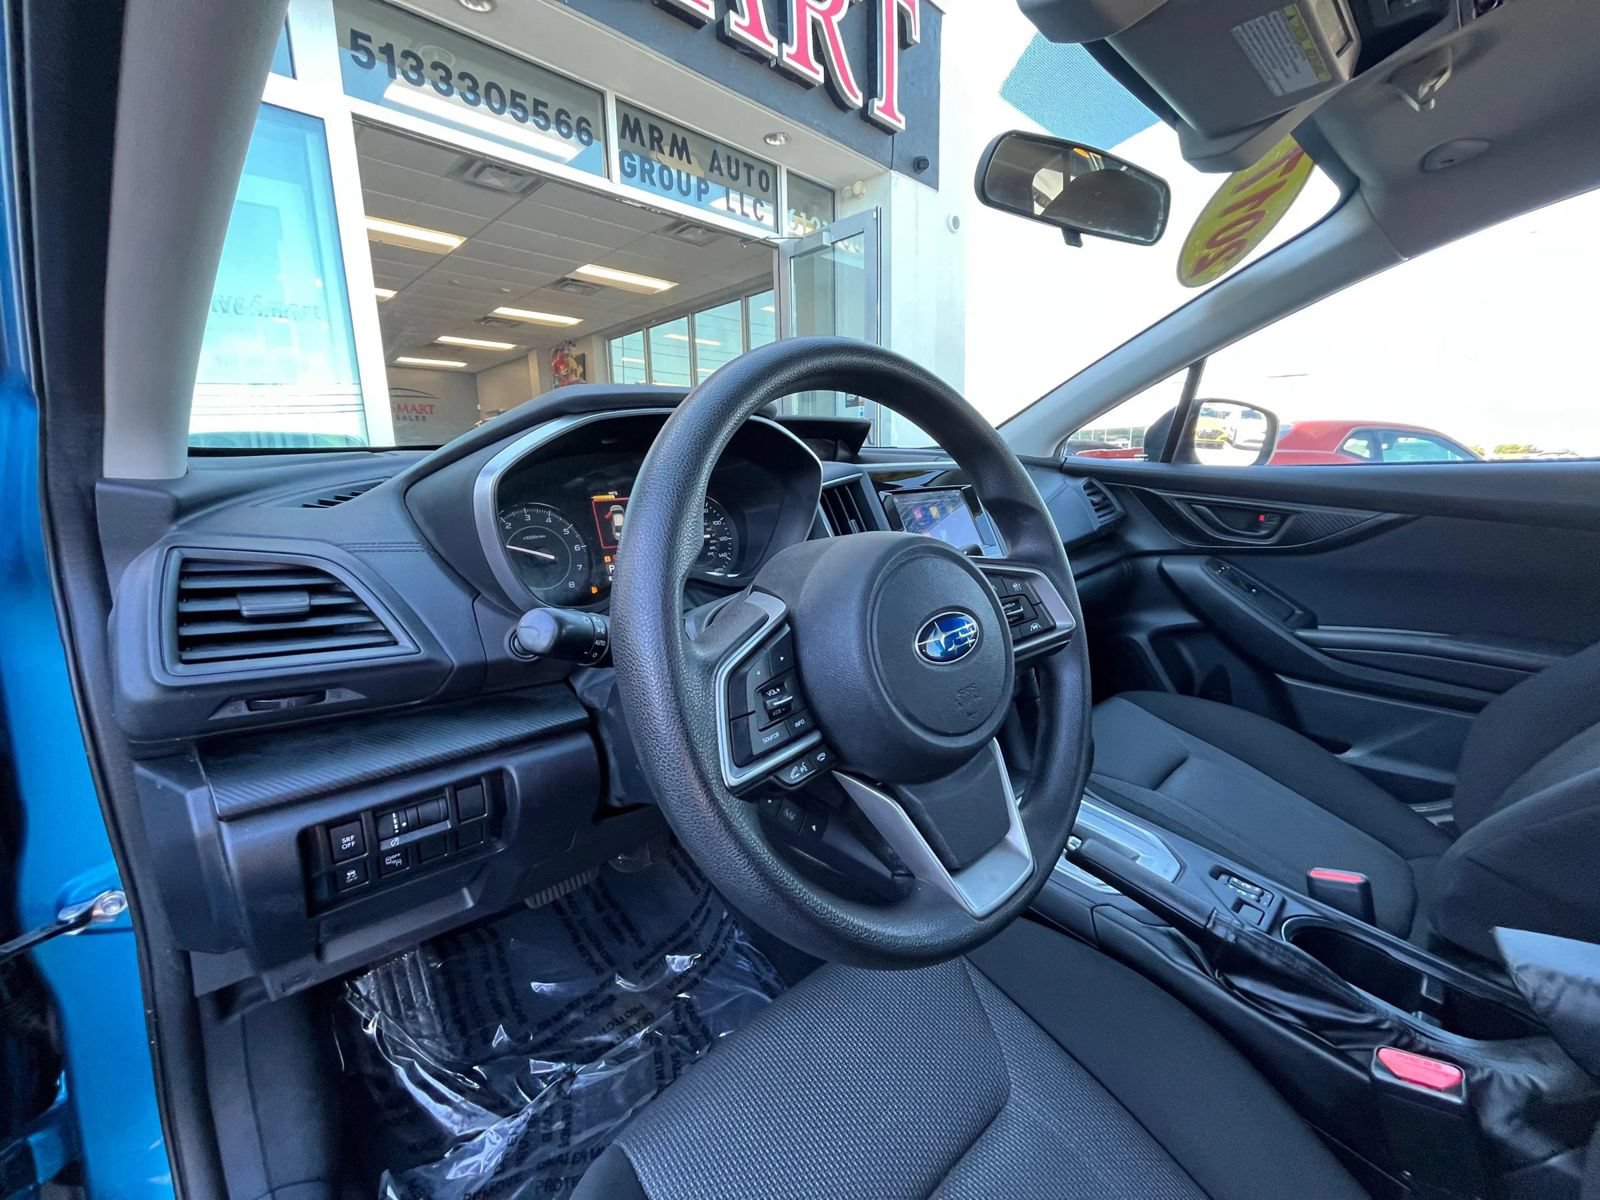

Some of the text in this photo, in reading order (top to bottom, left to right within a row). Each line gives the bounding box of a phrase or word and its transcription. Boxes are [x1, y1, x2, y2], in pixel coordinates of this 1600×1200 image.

[350, 28, 594, 147] 5133305566
[619, 150, 766, 222] GROUP LLC
[620, 112, 771, 193] MRM AUTO
[341, 834, 355, 844] SRF
[341, 841, 356, 850] OFF
